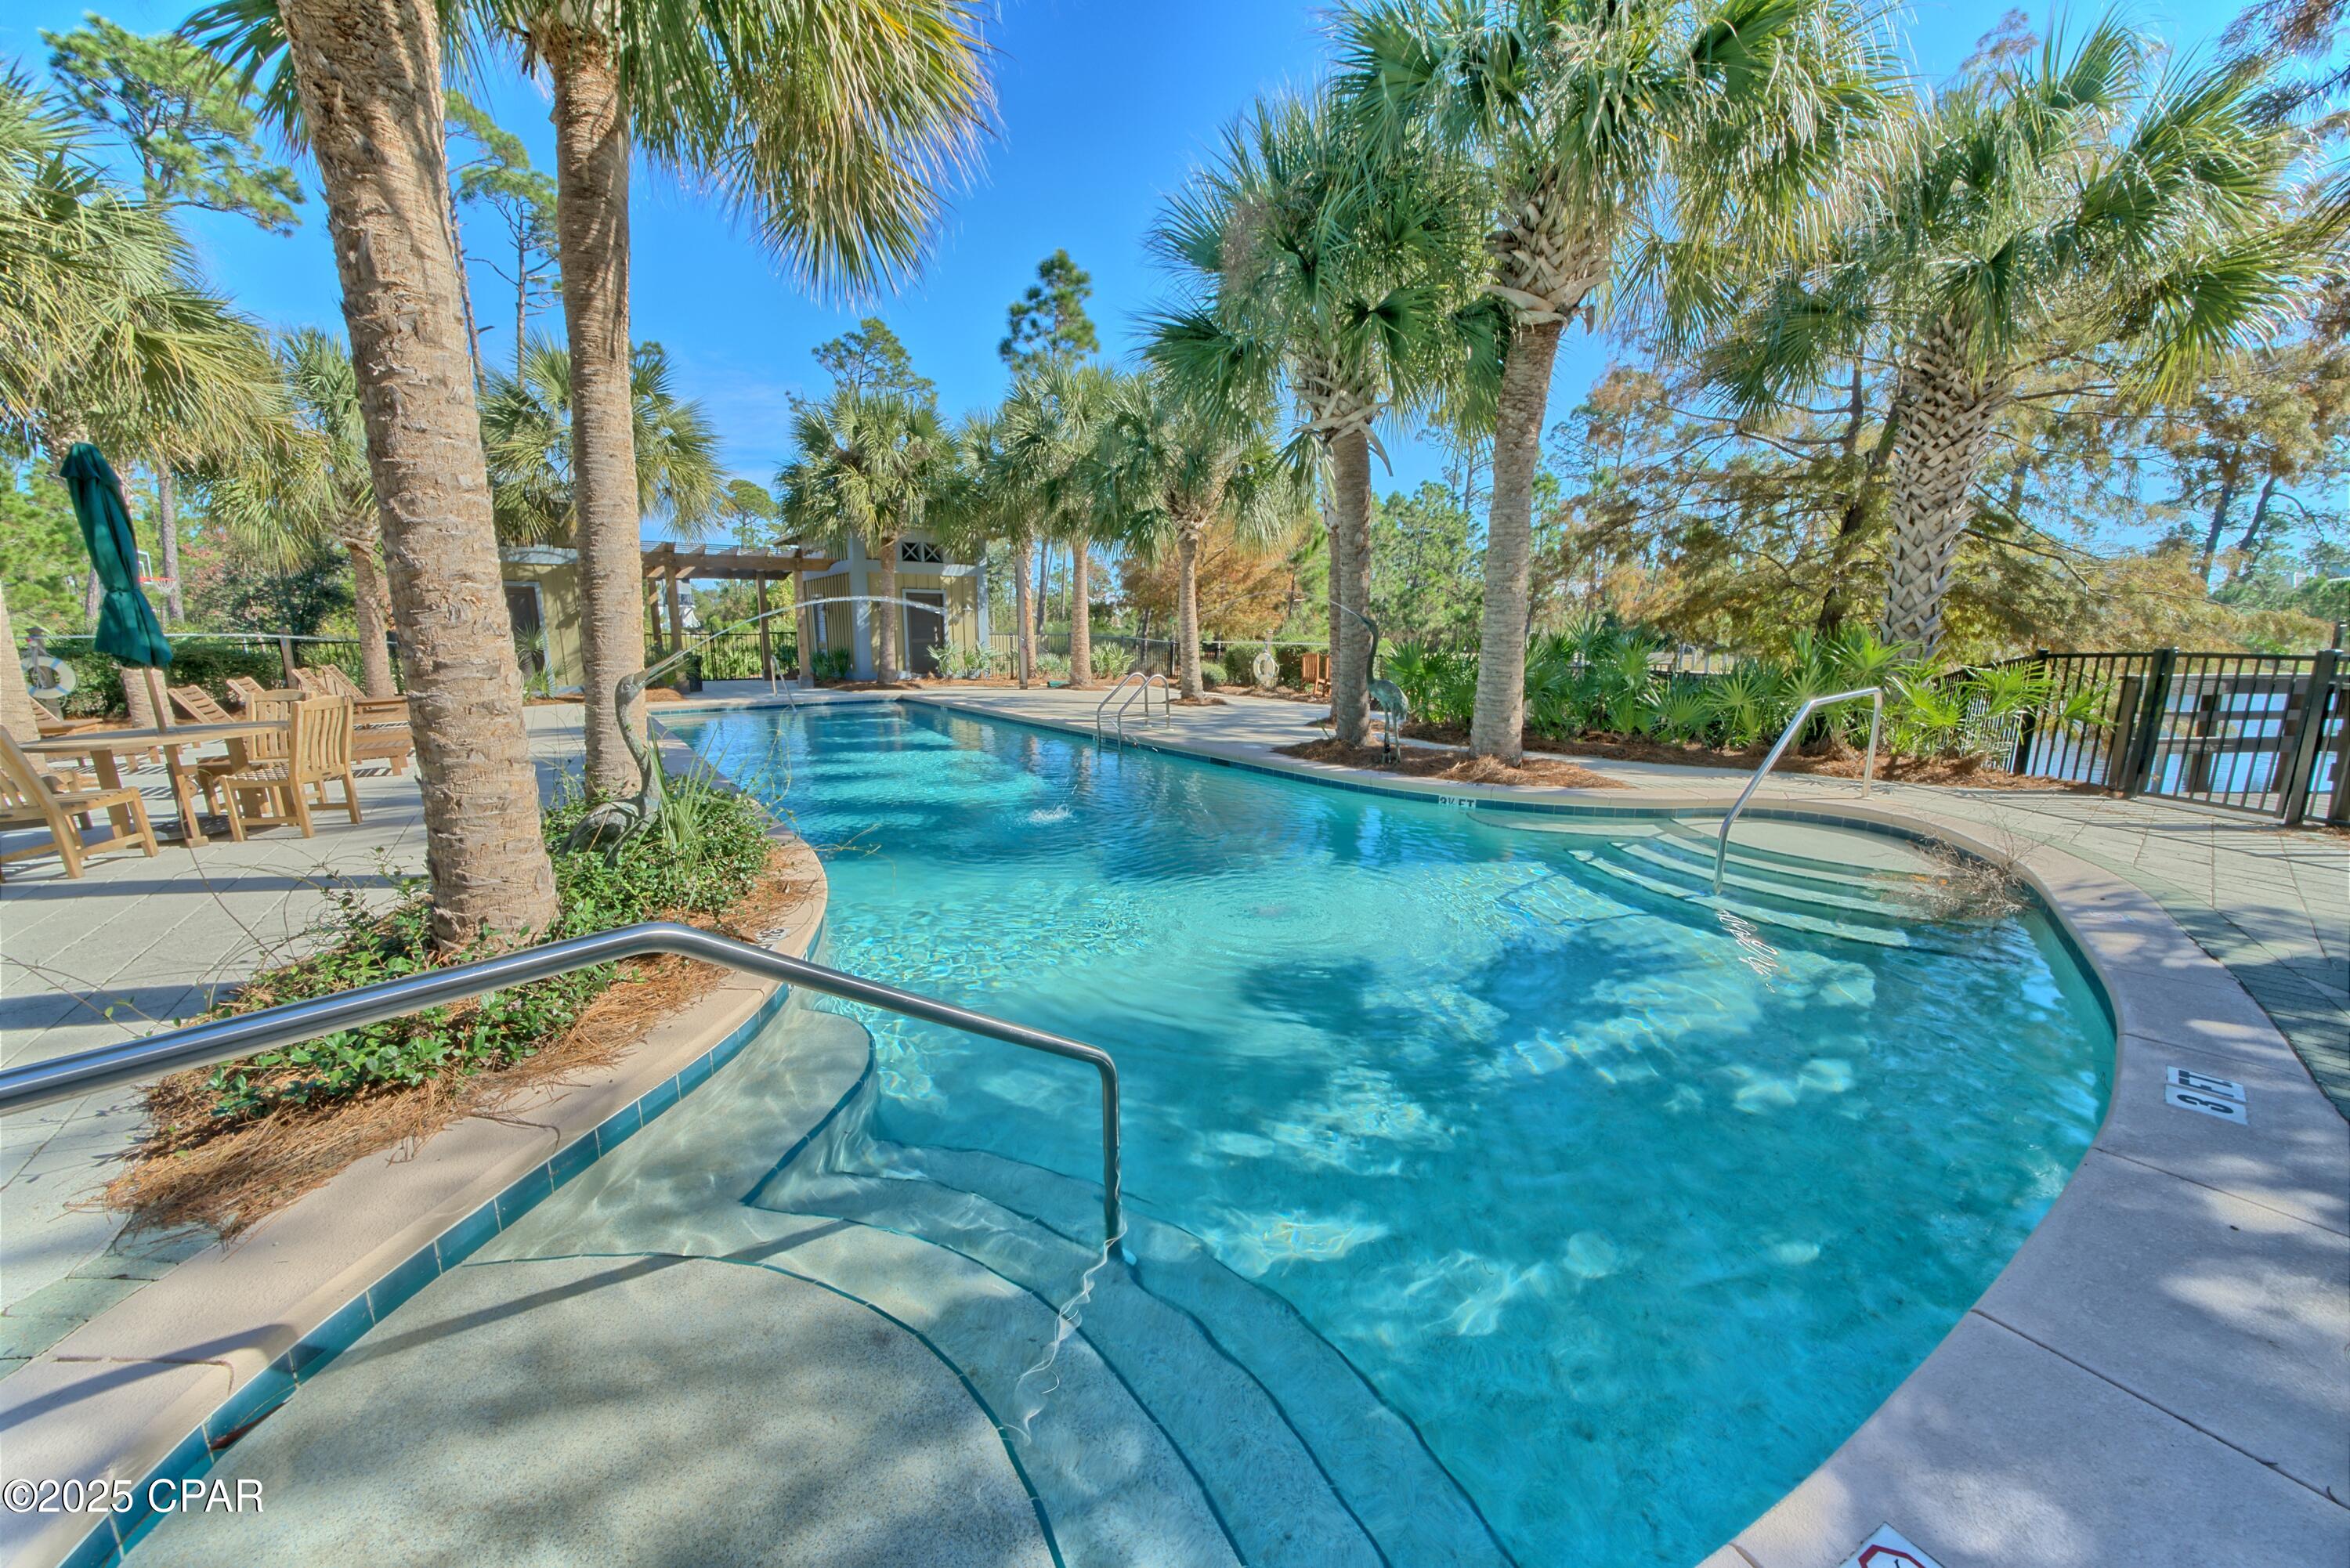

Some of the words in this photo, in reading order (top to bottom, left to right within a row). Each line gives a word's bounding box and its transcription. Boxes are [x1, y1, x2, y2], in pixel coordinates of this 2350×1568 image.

[1459, 798, 1474, 807] FT
[2178, 1069, 2234, 1098] FT
[2176, 1094, 2234, 1114] 3
